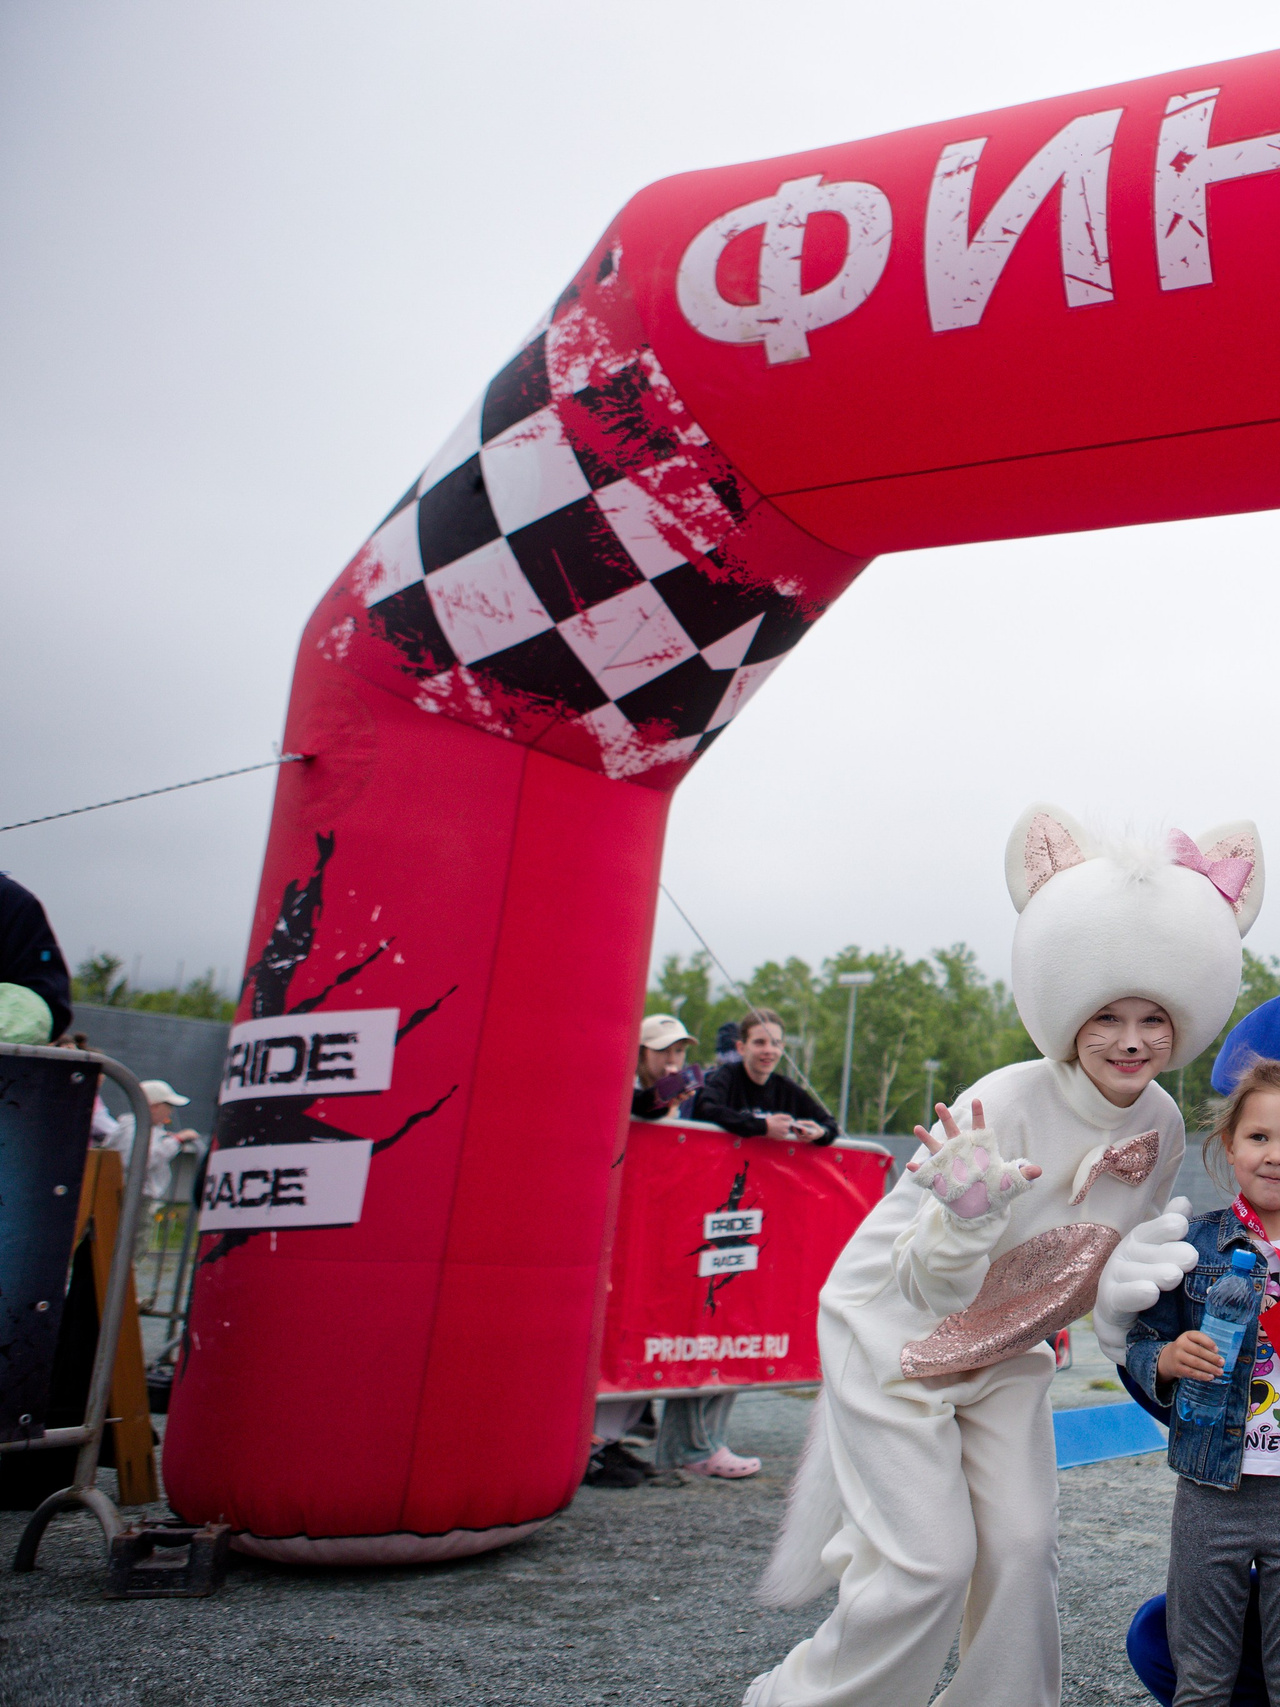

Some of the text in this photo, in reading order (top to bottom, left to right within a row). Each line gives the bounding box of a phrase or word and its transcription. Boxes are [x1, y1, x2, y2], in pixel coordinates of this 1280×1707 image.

[711, 1216, 755, 1234] PRIDE
[1247, 1219, 1265, 1239] OCR
[712, 1254, 746, 1268] RACE
[644, 1333, 789, 1363] PRIDERACE.RU
